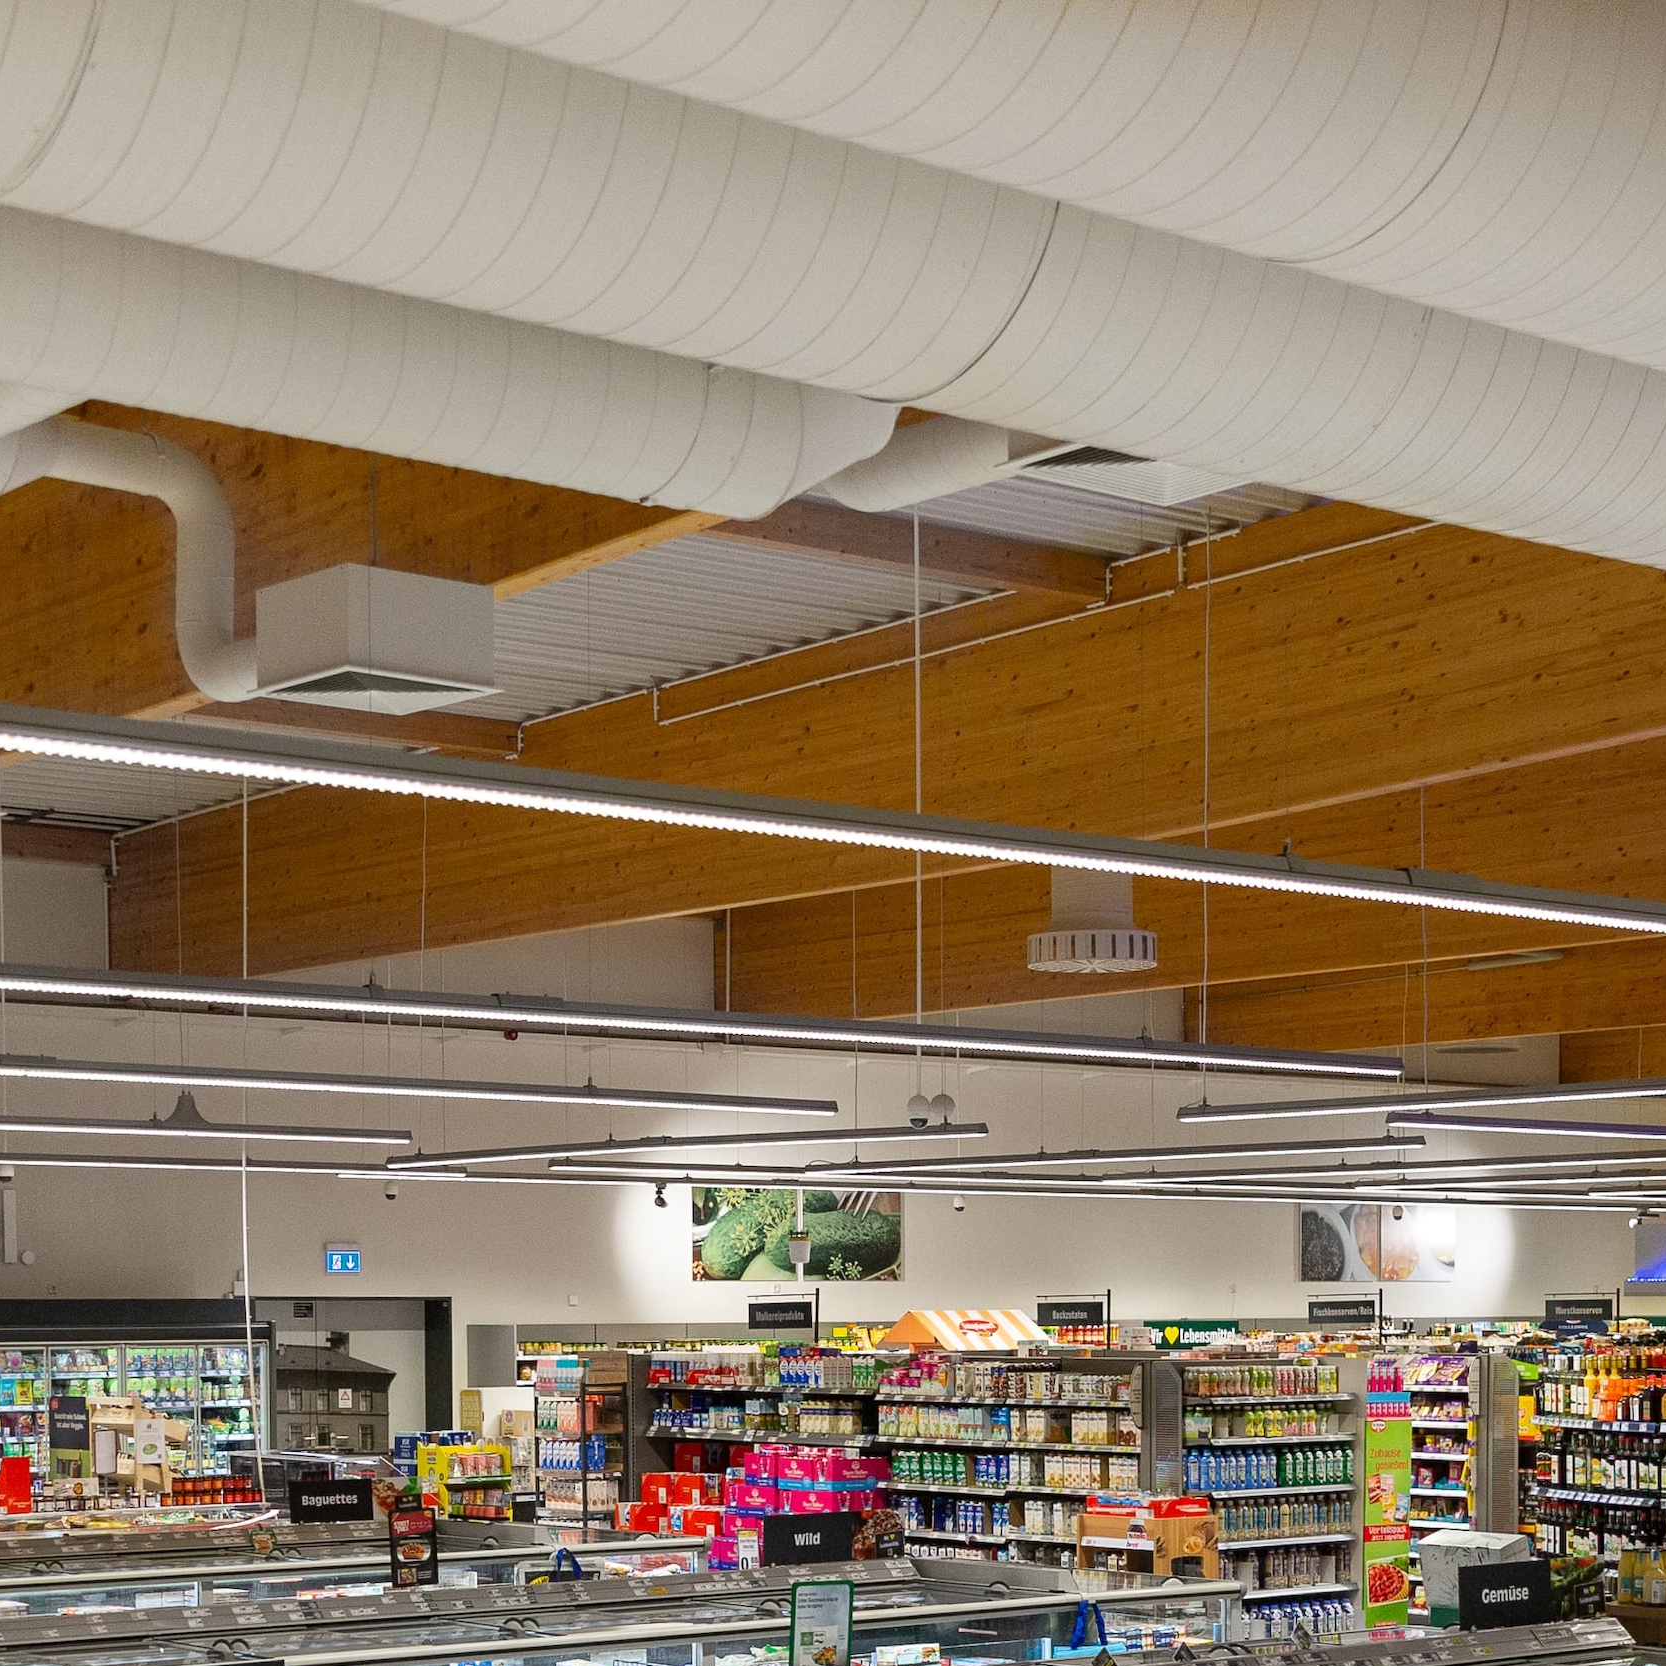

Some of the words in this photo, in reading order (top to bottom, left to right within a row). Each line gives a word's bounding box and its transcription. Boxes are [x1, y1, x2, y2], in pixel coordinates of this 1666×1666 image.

[301, 1493, 358, 1509] Baguettes
[794, 1532, 821, 1546] Wild
[1482, 1585, 1530, 1604] Gemüse
